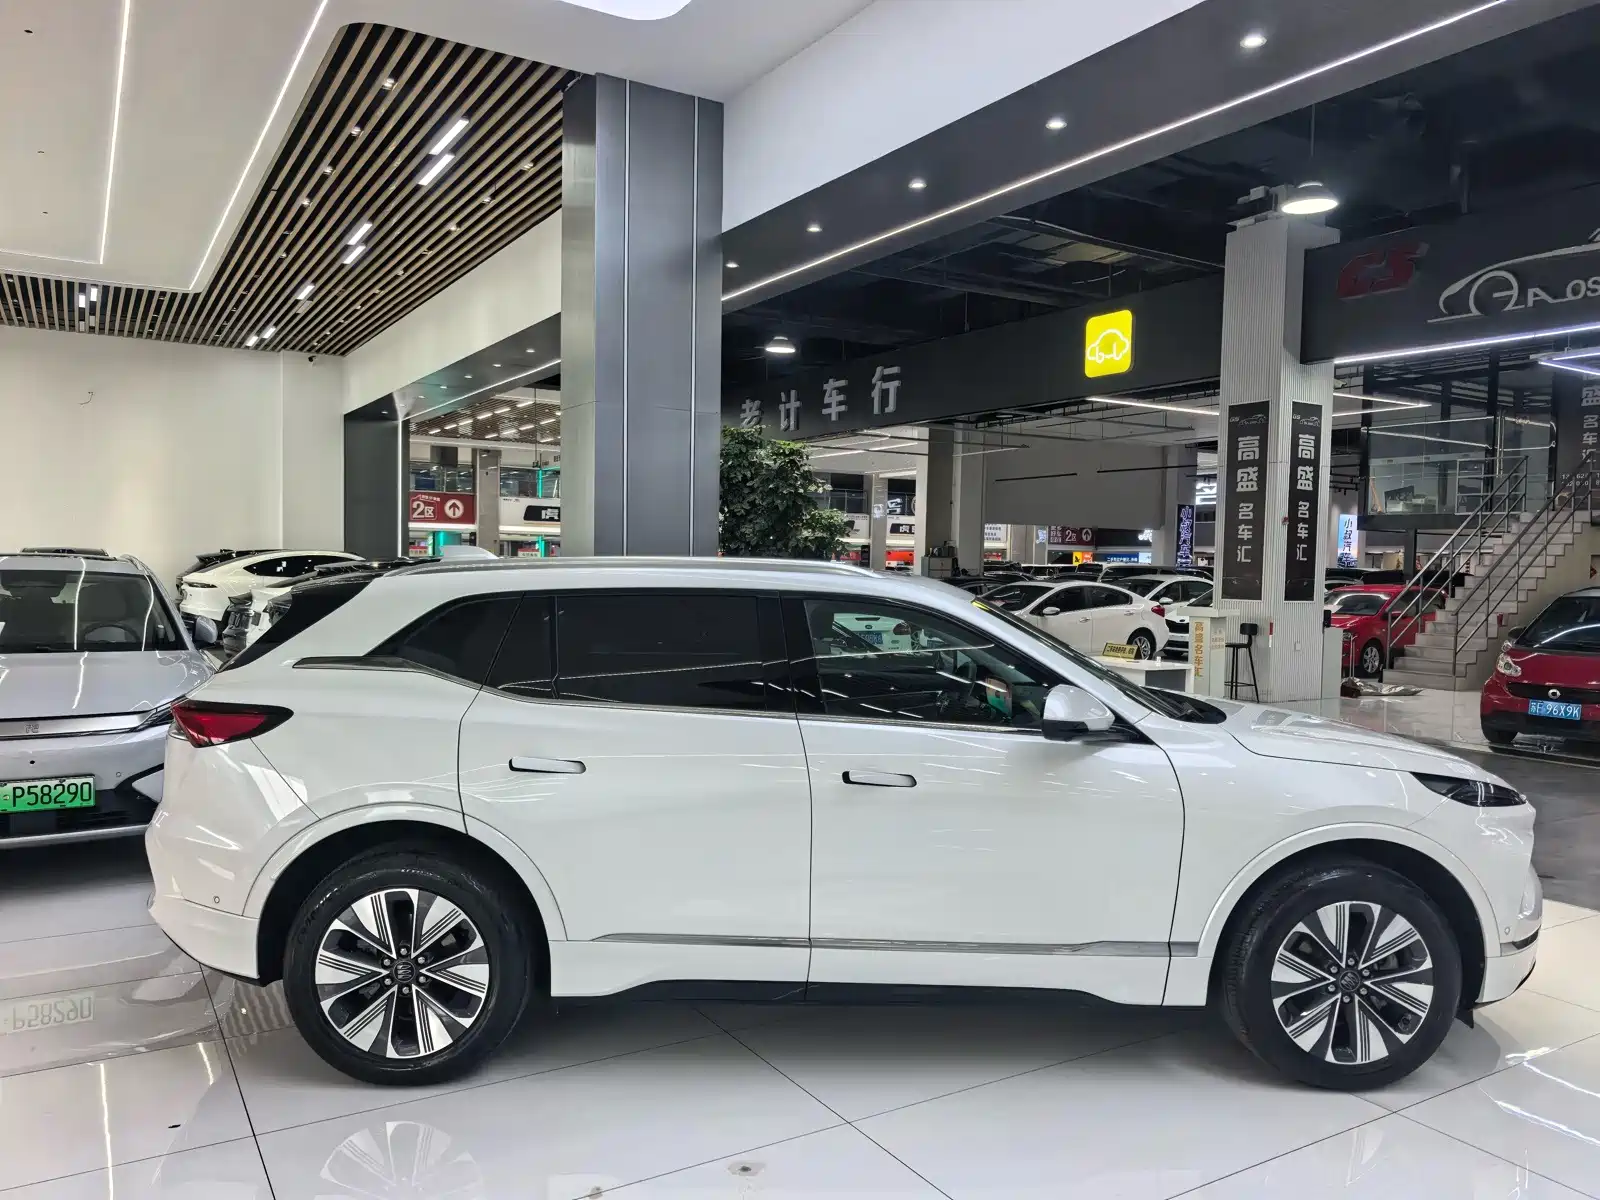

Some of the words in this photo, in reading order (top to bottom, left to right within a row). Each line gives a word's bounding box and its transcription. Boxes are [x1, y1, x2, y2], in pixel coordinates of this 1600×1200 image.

[739, 365, 901, 430] 老计车行
[412, 501, 435, 519] 2区
